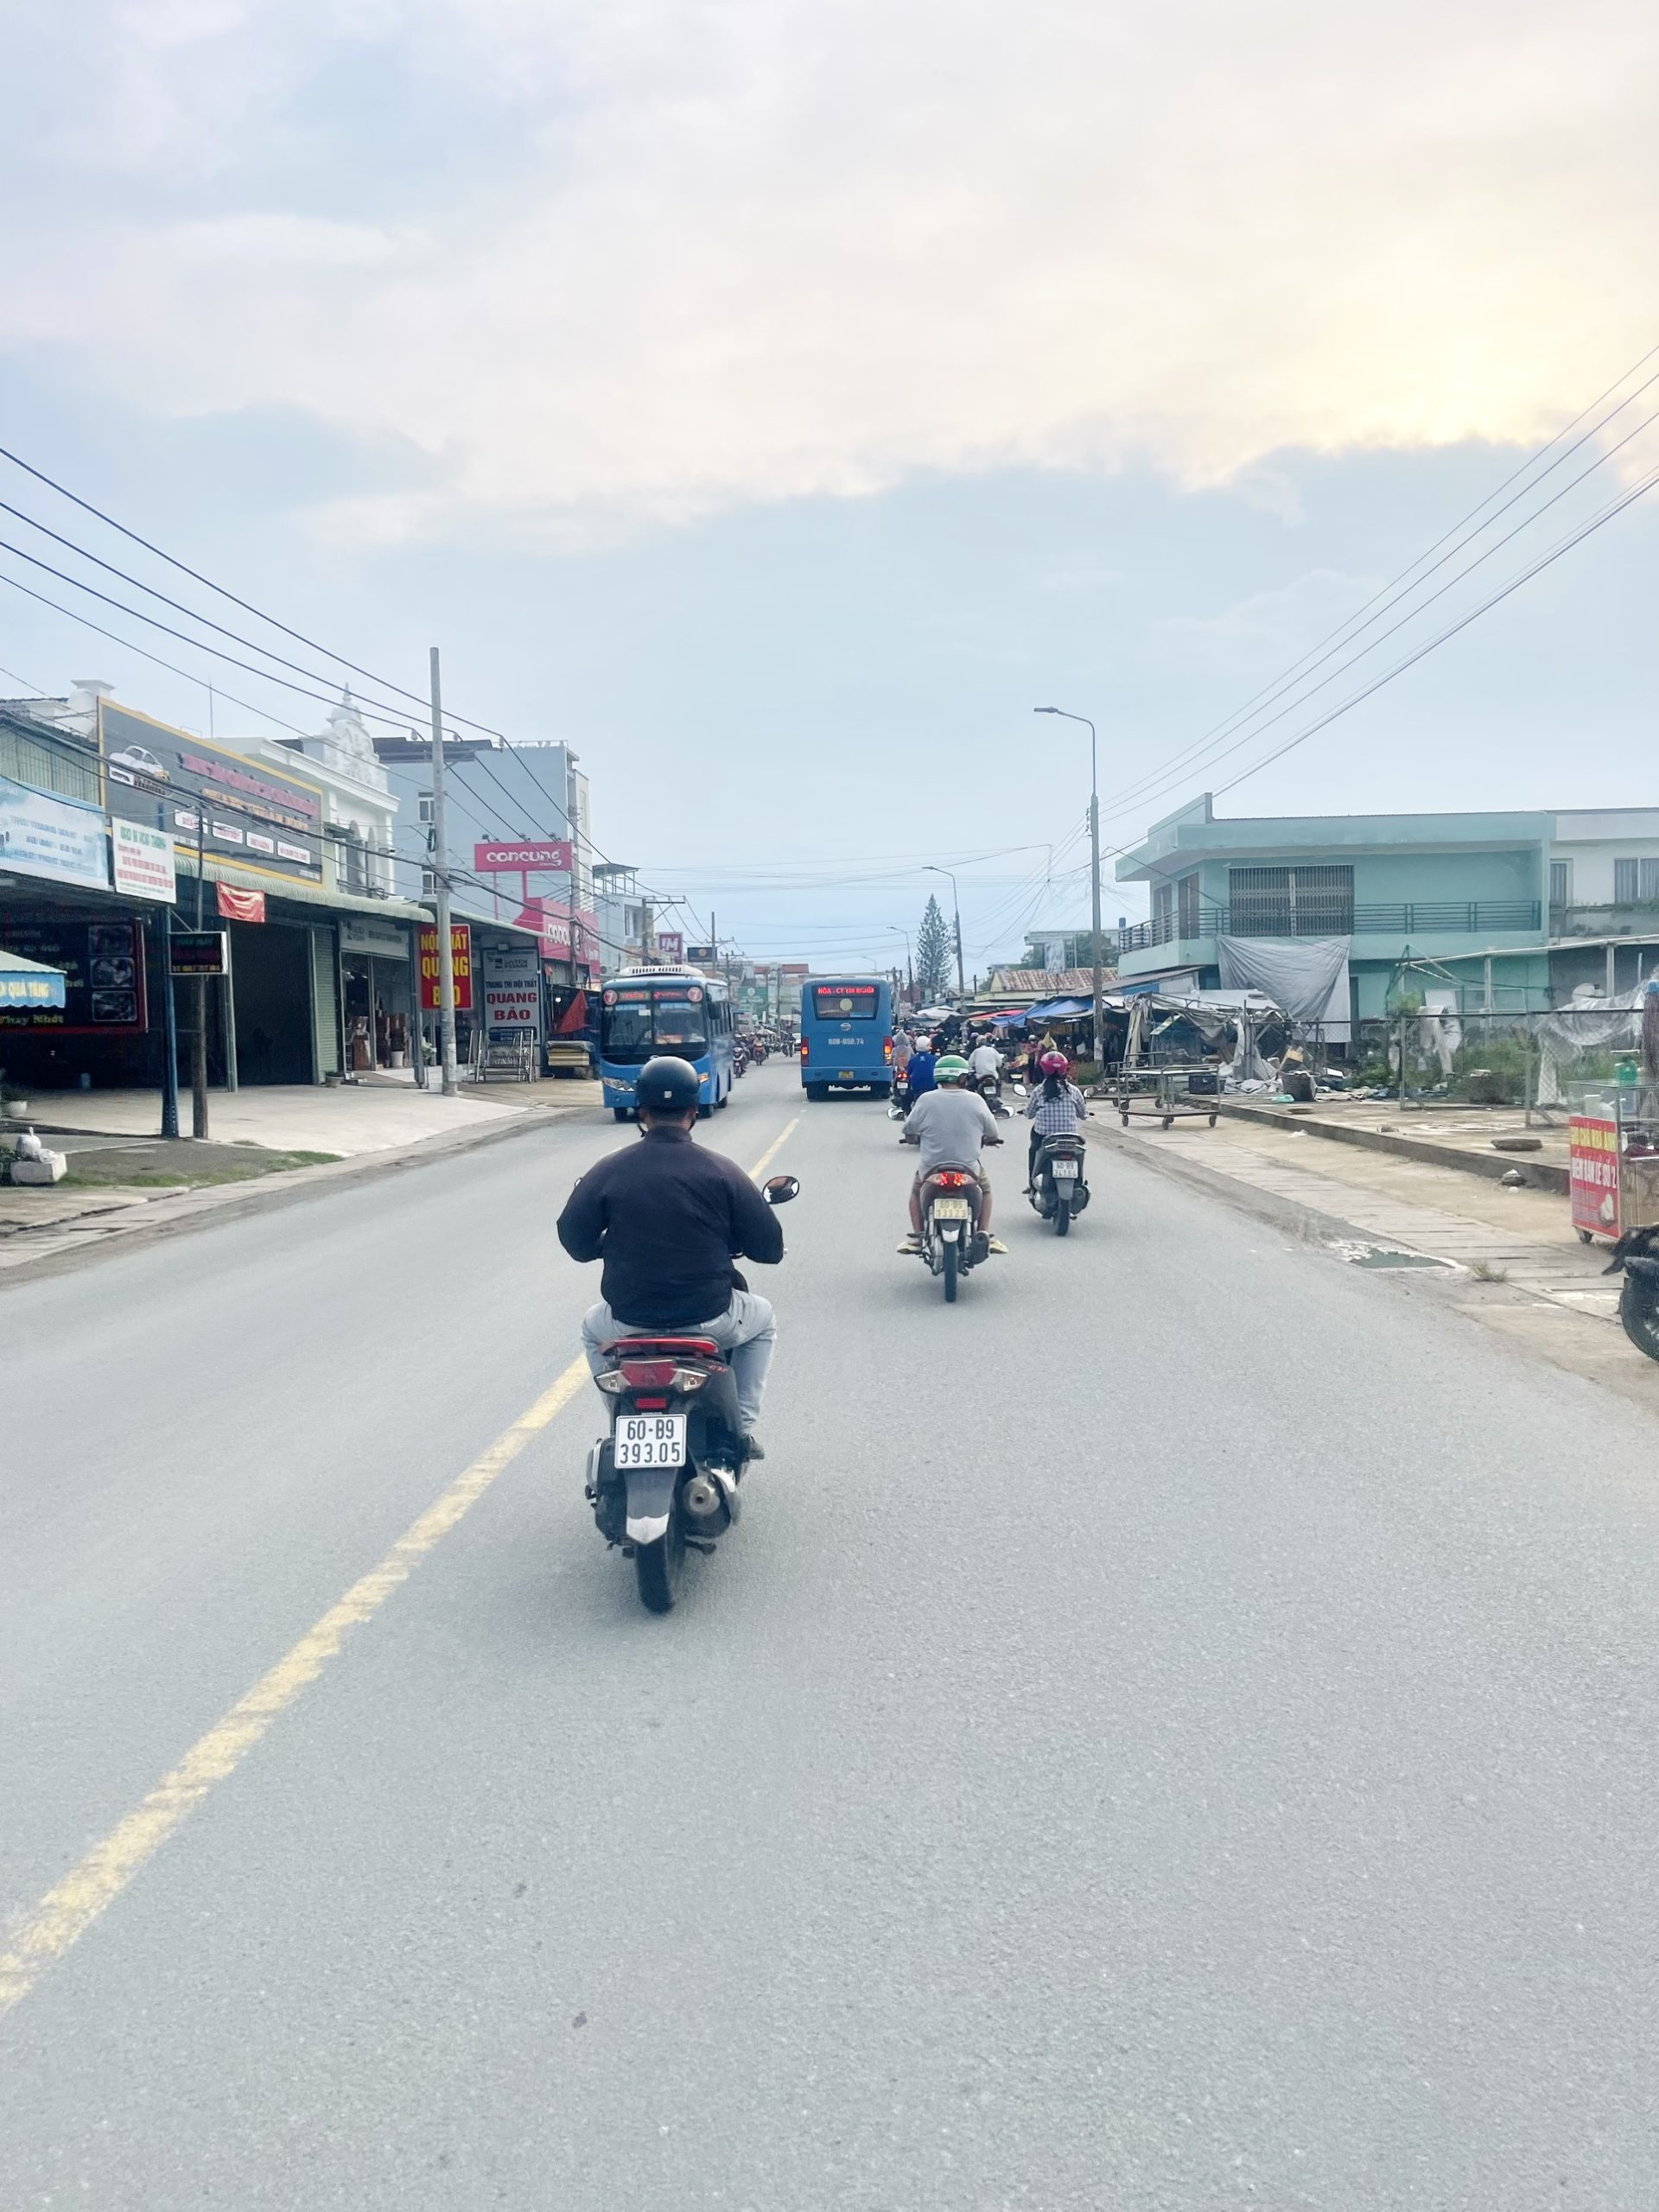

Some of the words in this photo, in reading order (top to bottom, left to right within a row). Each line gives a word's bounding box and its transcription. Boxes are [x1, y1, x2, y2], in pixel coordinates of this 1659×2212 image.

[422, 956, 468, 979] QUNG
[433, 985, 461, 1006] BO
[486, 992, 537, 1005] QUANG
[627, 1420, 674, 1440] 60-B9
[620, 1442, 681, 1464] 393.05
